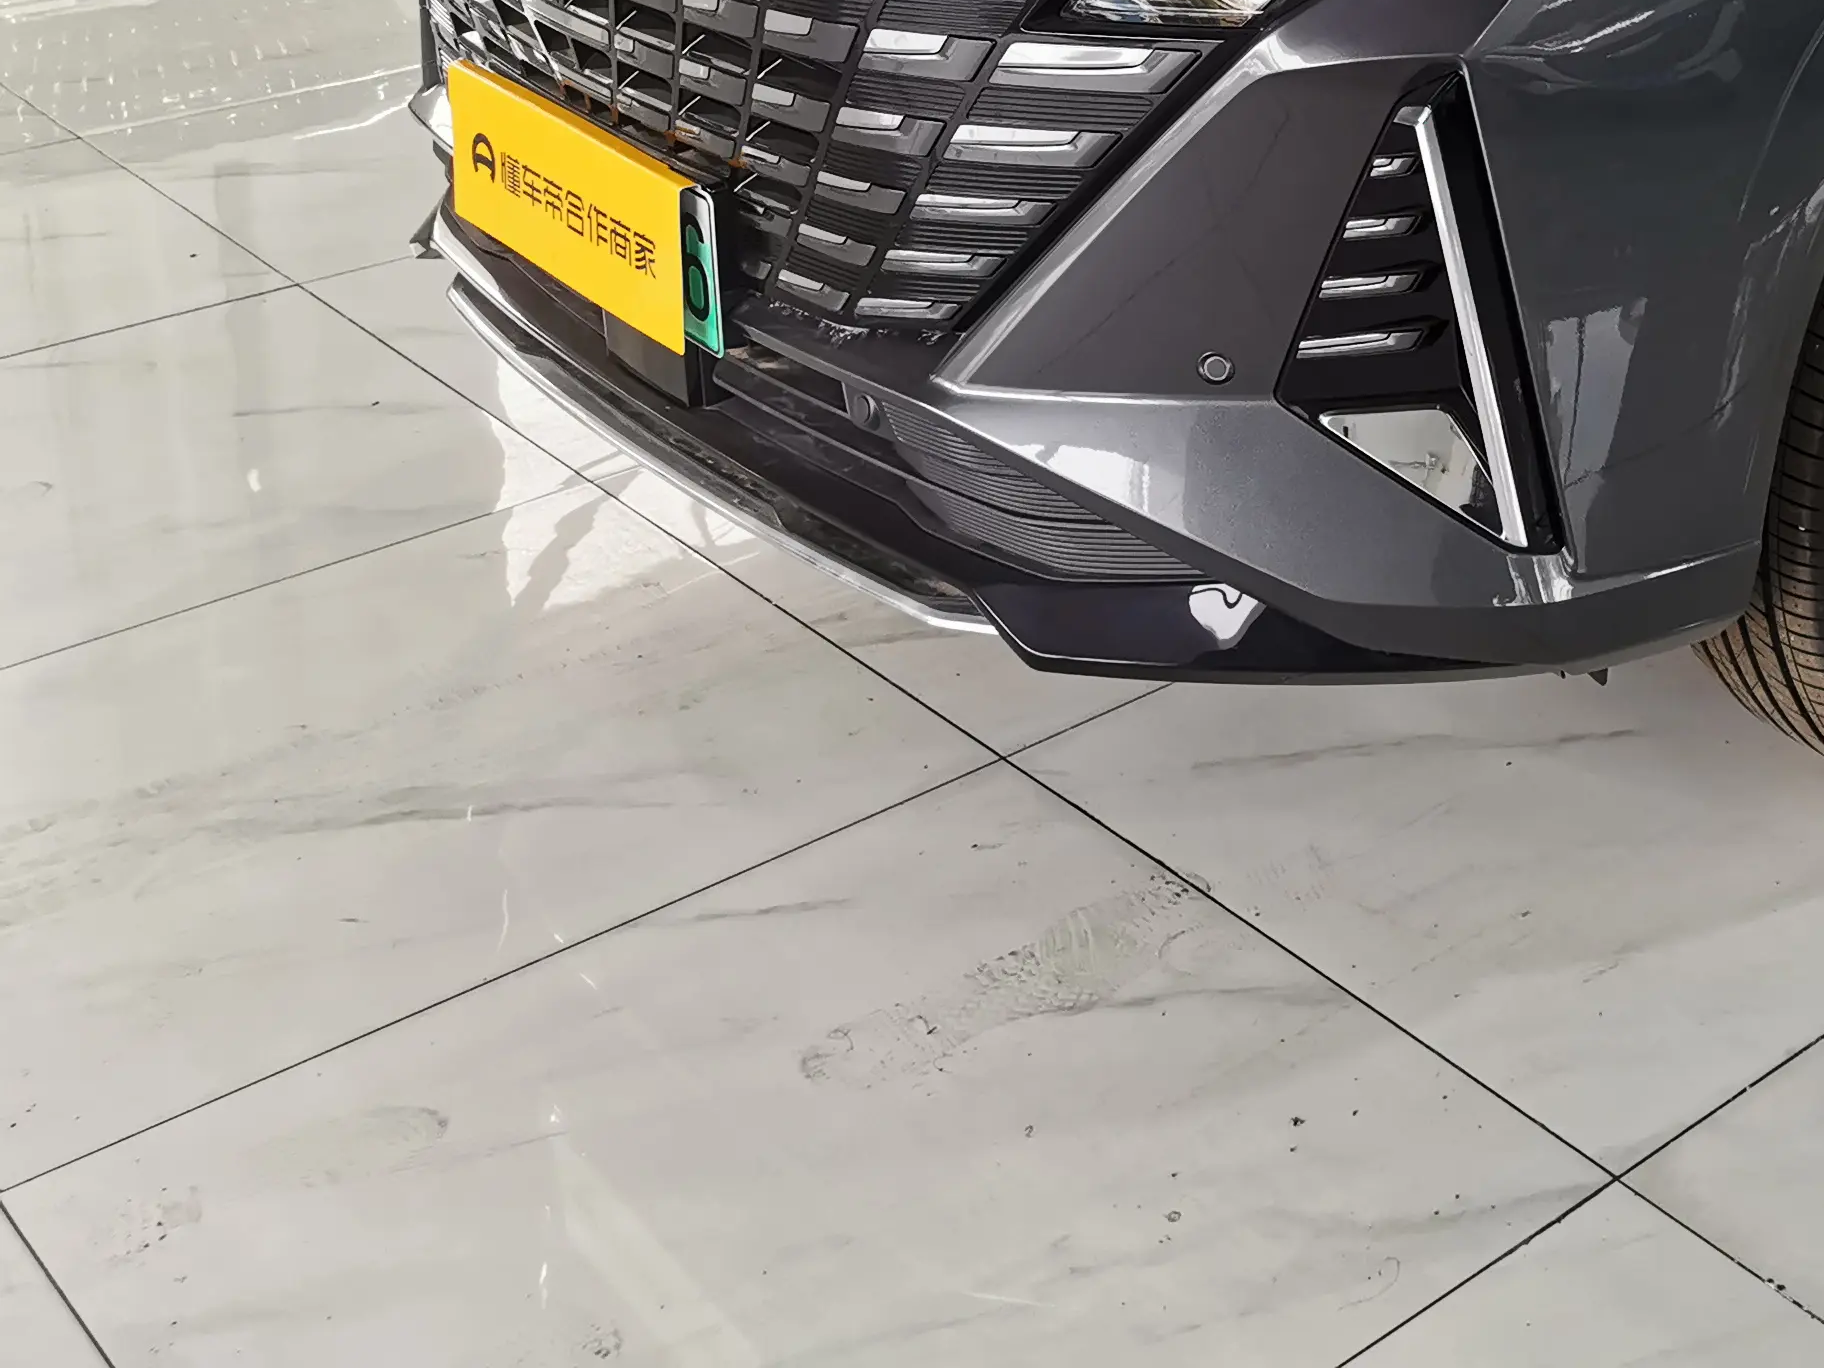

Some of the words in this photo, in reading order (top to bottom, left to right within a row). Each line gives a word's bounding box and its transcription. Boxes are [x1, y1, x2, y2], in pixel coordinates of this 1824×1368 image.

[500, 151, 657, 280] 懂车帝合作商家
